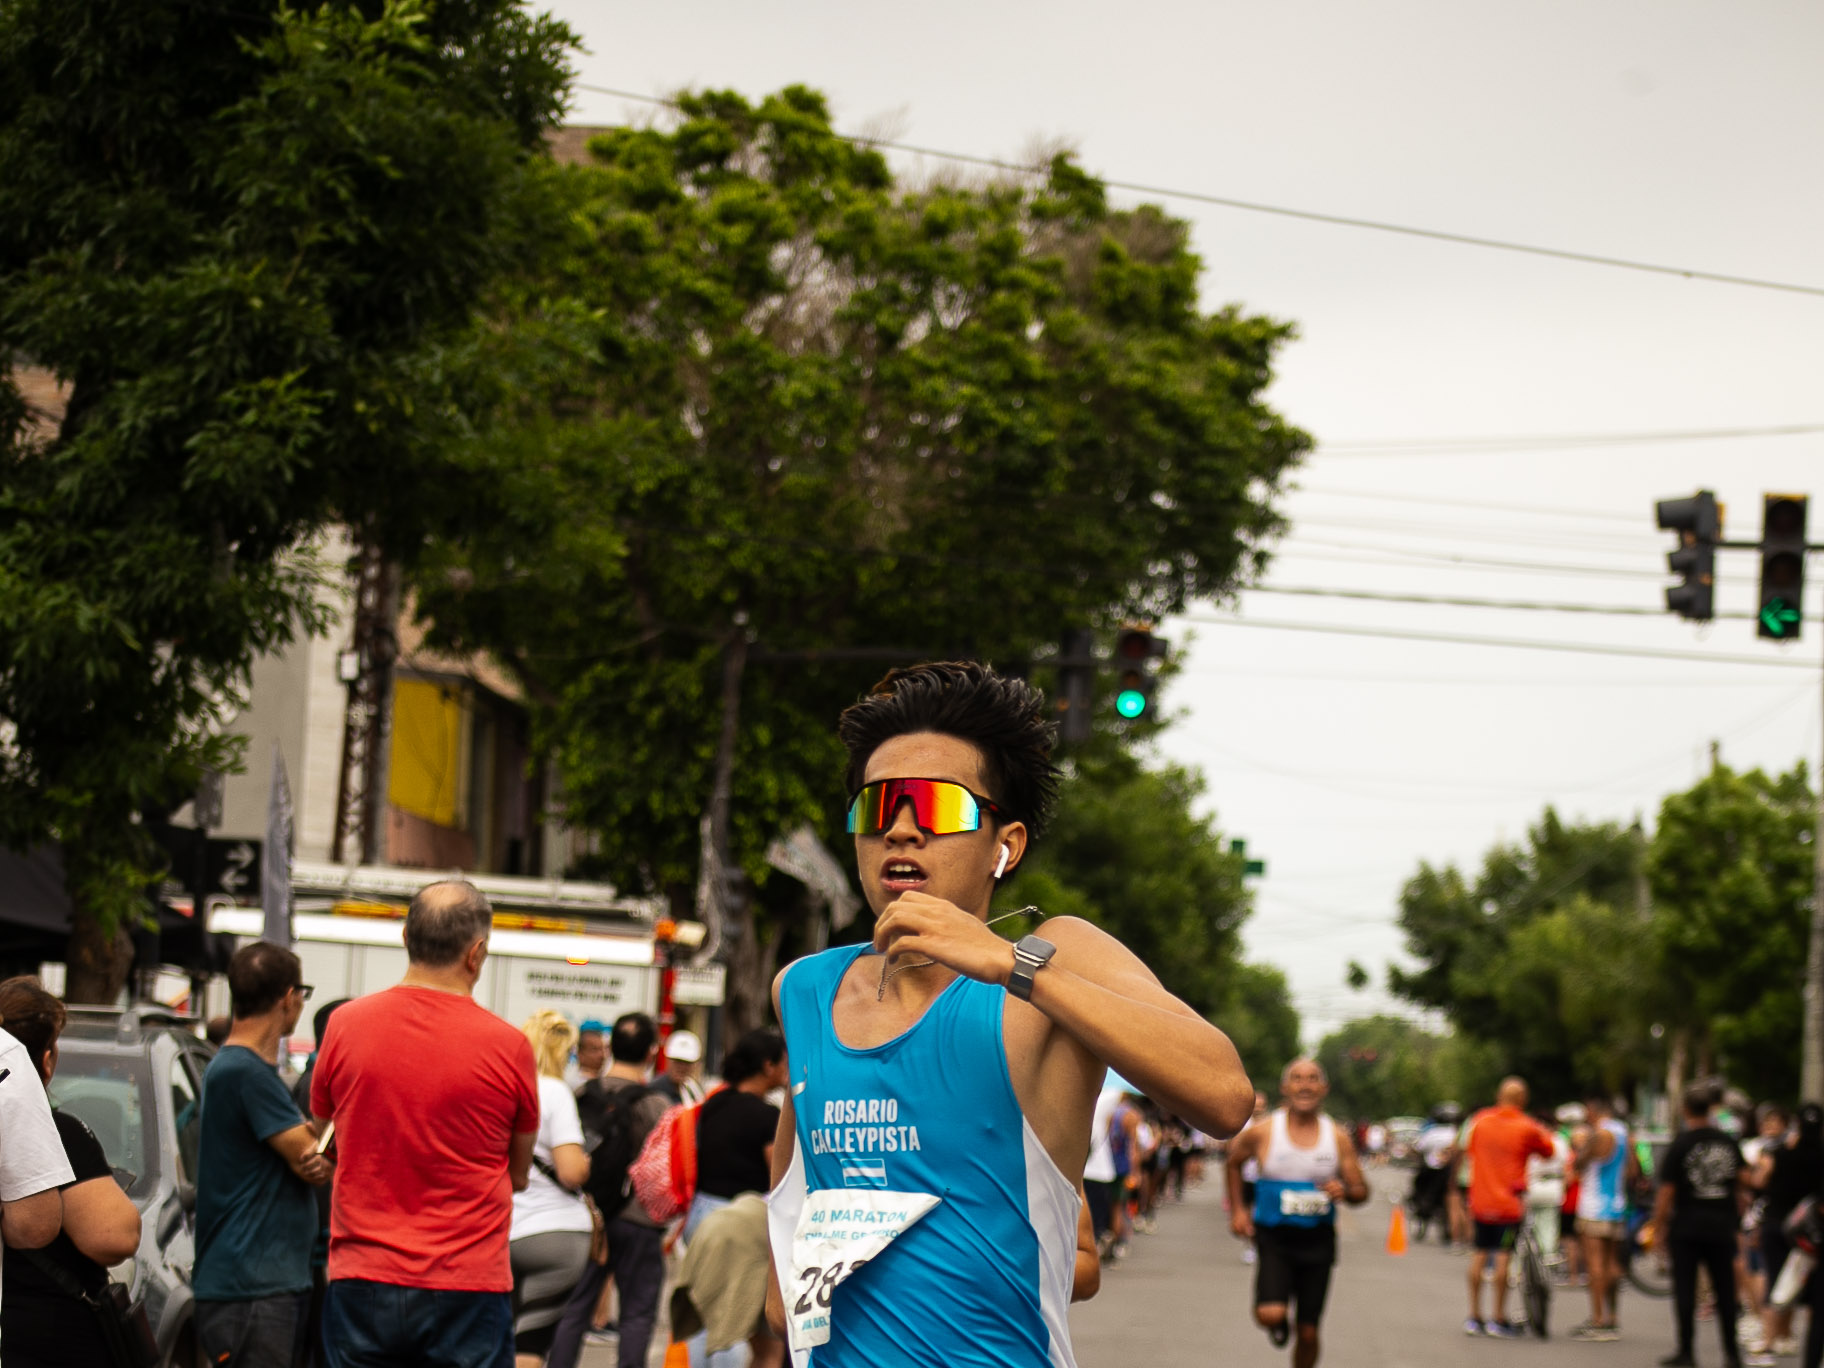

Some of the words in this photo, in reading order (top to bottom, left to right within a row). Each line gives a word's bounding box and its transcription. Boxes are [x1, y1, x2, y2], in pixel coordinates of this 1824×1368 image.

[823, 1099, 898, 1125] ROSARIO
[811, 1125, 921, 1155] CALLEYPISTA
[811, 1210, 826, 1223] 40
[830, 1209, 908, 1224] MARATON
